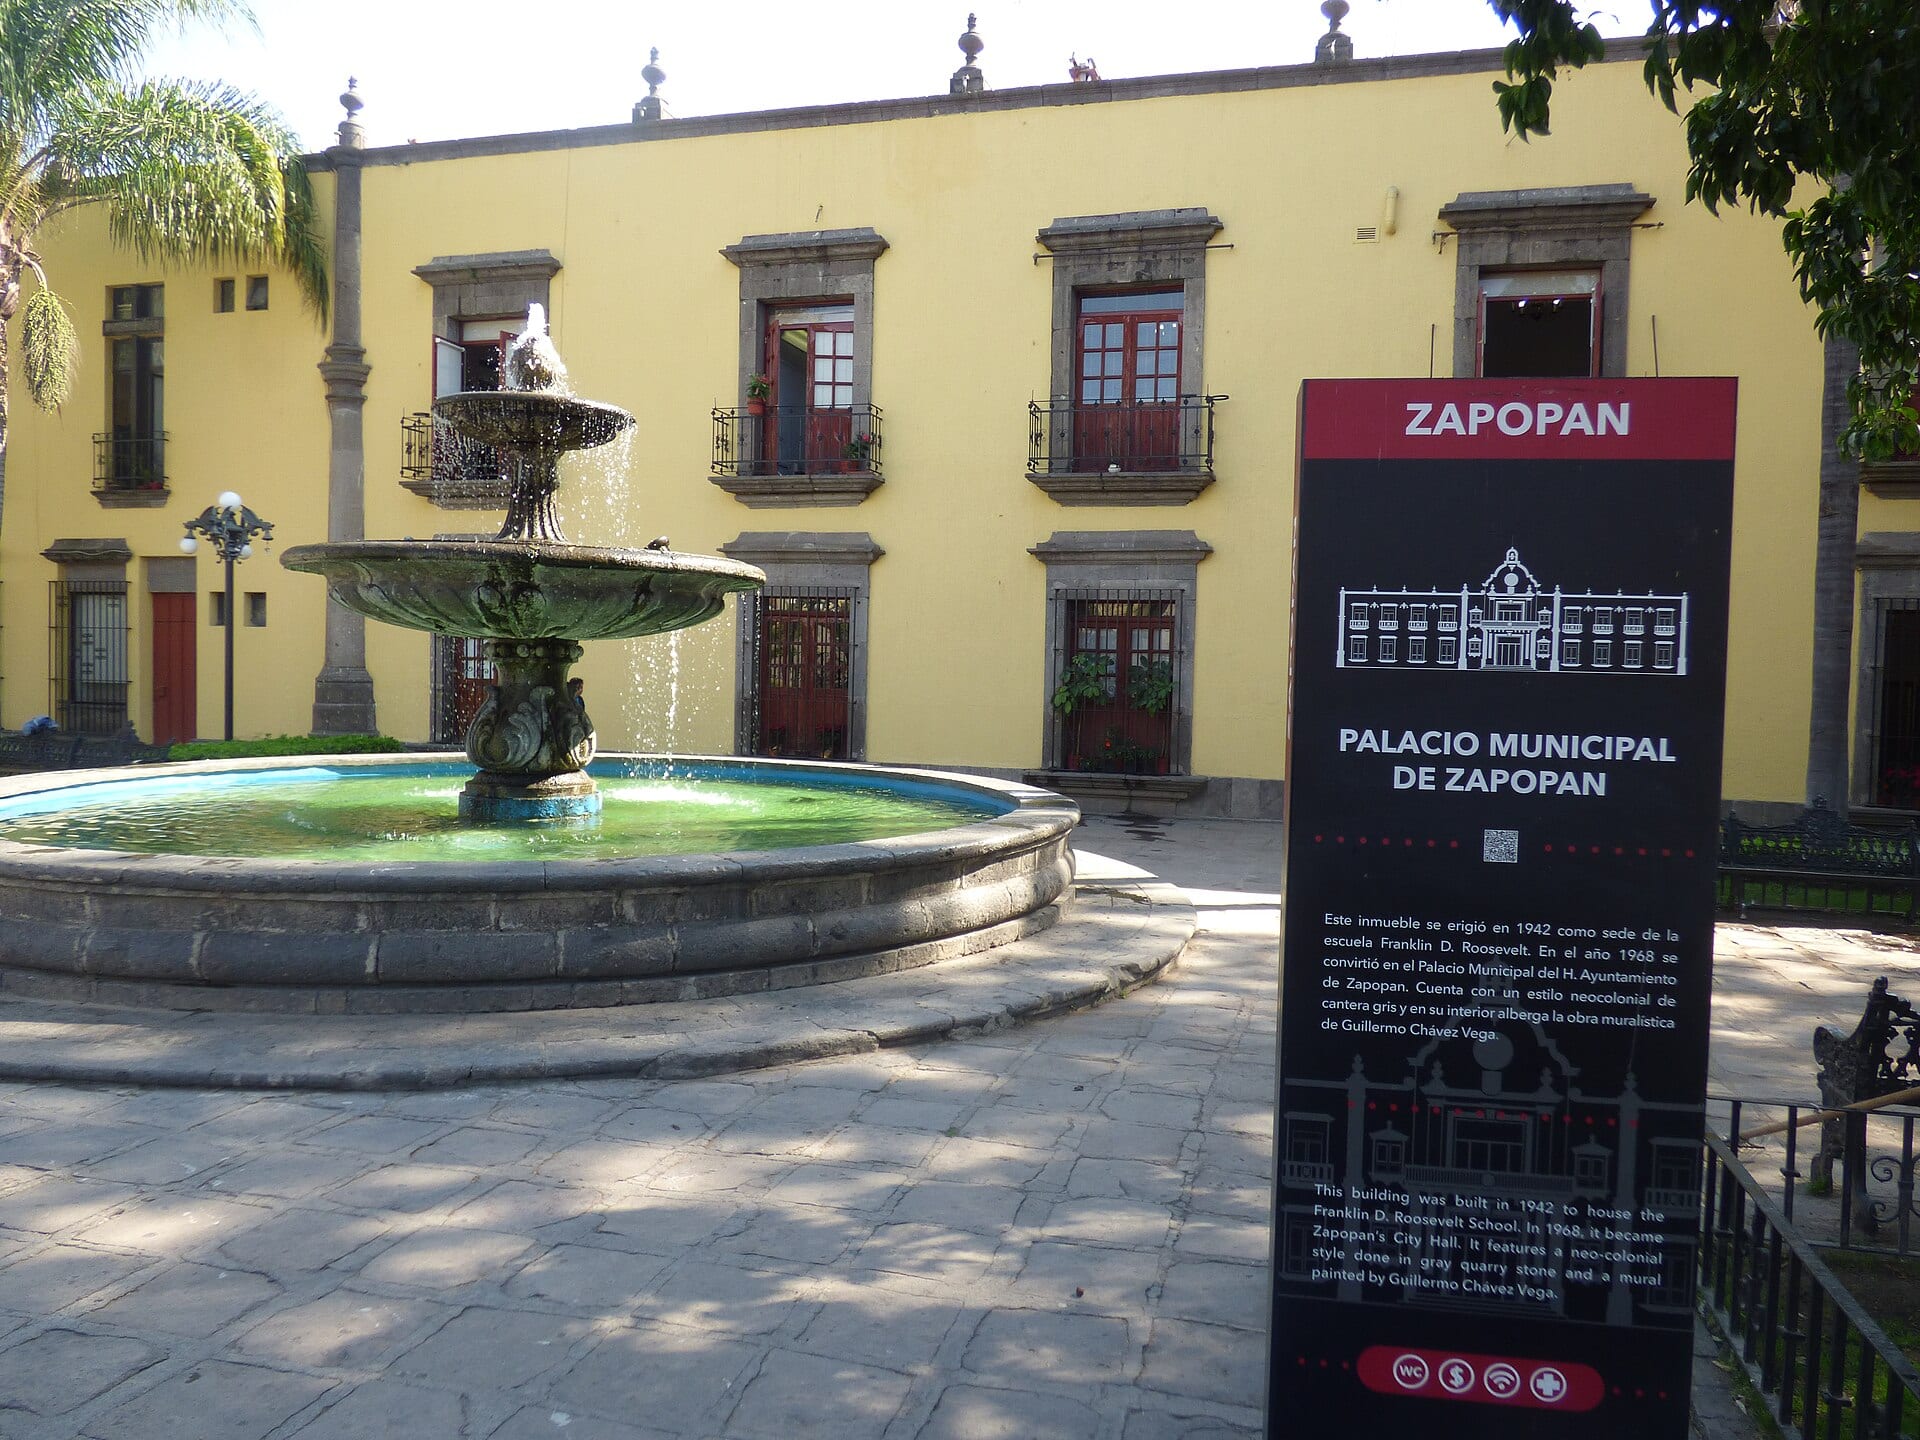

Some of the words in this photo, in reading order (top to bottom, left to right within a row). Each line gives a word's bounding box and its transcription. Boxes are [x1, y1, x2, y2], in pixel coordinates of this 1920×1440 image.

[1405, 402, 1629, 436] ZAPOPAN
[1339, 729, 1479, 757] PALACIO
[1490, 733, 1676, 762] MUNICIPAL
[1393, 766, 1435, 791] DE
[1445, 768, 1606, 796] ZAPOPAN
[1324, 913, 1352, 926] Este
[1358, 914, 1420, 930] inmueble
[1426, 919, 1441, 930] se
[1447, 920, 1487, 936] erigió
[1492, 922, 1510, 934] en
[1516, 922, 1551, 936] 1942
[1557, 926, 1596, 938] como
[1602, 927, 1636, 940] sede
[1642, 929, 1660, 941] de
[1666, 929, 1680, 942] la
[1324, 935, 1373, 948] escuela
[1380, 938, 1432, 951] Franklin
[1440, 940, 1455, 952] D.
[1462, 941, 1531, 956] Roosevelt.
[1539, 945, 1556, 957] En
[1564, 945, 1577, 959] el
[1584, 947, 1610, 960] año
[1619, 949, 1655, 962] 1968
[1662, 952, 1678, 964] se
[1323, 956, 1380, 969] convirtió
[1383, 960, 1400, 970] en
[1403, 959, 1415, 971] el
[1418, 960, 1465, 974] Palacio
[1468, 963, 1534, 980] Municipal
[1538, 966, 1559, 979] del
[1563, 968, 1578, 980] H.
[1580, 969, 1677, 986] Ayuntamiento
[1322, 976, 1340, 989] de
[1346, 978, 1409, 994] Zapopan.
[1415, 982, 1464, 996] Cuenta
[1471, 986, 1496, 998] con
[1503, 988, 1520, 999] un
[1527, 987, 1563, 1001] estilo
[1570, 990, 1650, 1006] neocolonial
[1657, 994, 1676, 1007] de
[1321, 1000, 1370, 1012] cantera
[1372, 1001, 1397, 1016] gris
[1399, 1004, 1407, 1017] y
[1410, 1004, 1426, 1014] en
[1429, 1004, 1444, 1016] su
[1447, 1005, 1495, 1019] interior
[1497, 1007, 1549, 1024] alberga
[1552, 1009, 1564, 1022] la
[1567, 1010, 1598, 1025] obra
[1321, 1018, 1338, 1030] de
[1341, 1020, 1406, 1035] Guillermo
[1410, 1023, 1459, 1038] Chávez
[1461, 1027, 1499, 1044] Vega.
[1314, 1184, 1343, 1197] This
[1351, 1186, 1410, 1205] building
[1418, 1195, 1446, 1206] was
[1455, 1195, 1488, 1210] built
[1496, 1197, 1509, 1211] in
[1519, 1199, 1554, 1214] 1942
[1563, 1203, 1578, 1216] to
[1587, 1204, 1632, 1221] house
[1640, 1208, 1665, 1223] the
[1314, 1205, 1369, 1220] Franklin
[1374, 1209, 1389, 1222] D.
[1394, 1211, 1464, 1229] Roosevelt
[1468, 1217, 1521, 1233] School.
[1526, 1221, 1540, 1234] In
[1589, 1225, 1600, 1239] it
[1604, 1227, 1664, 1243] became
[1393, 1232, 1422, 1248] City
[1430, 1234, 1462, 1249] Hall.
[1470, 1238, 1480, 1250] It
[1487, 1238, 1546, 1256] features
[1553, 1245, 1563, 1257] a
[1570, 1247, 1663, 1265] neo-colonial
[1312, 1246, 1345, 1262] style
[1354, 1250, 1390, 1264] done
[1399, 1251, 1412, 1265] in
[1420, 1257, 1452, 1272] gray
[1460, 1261, 1508, 1276] quarry
[1516, 1263, 1557, 1278] stone
[1565, 1268, 1593, 1281] and
[1601, 1271, 1611, 1282] a
[1619, 1270, 1661, 1286] mural
[1311, 1266, 1365, 1283] painted
[1368, 1270, 1386, 1285] by
[1389, 1272, 1459, 1290] Guillermo
[1462, 1277, 1514, 1295] Chávez
[1517, 1284, 1558, 1300] Vega.
[1399, 1364, 1423, 1379] WC
